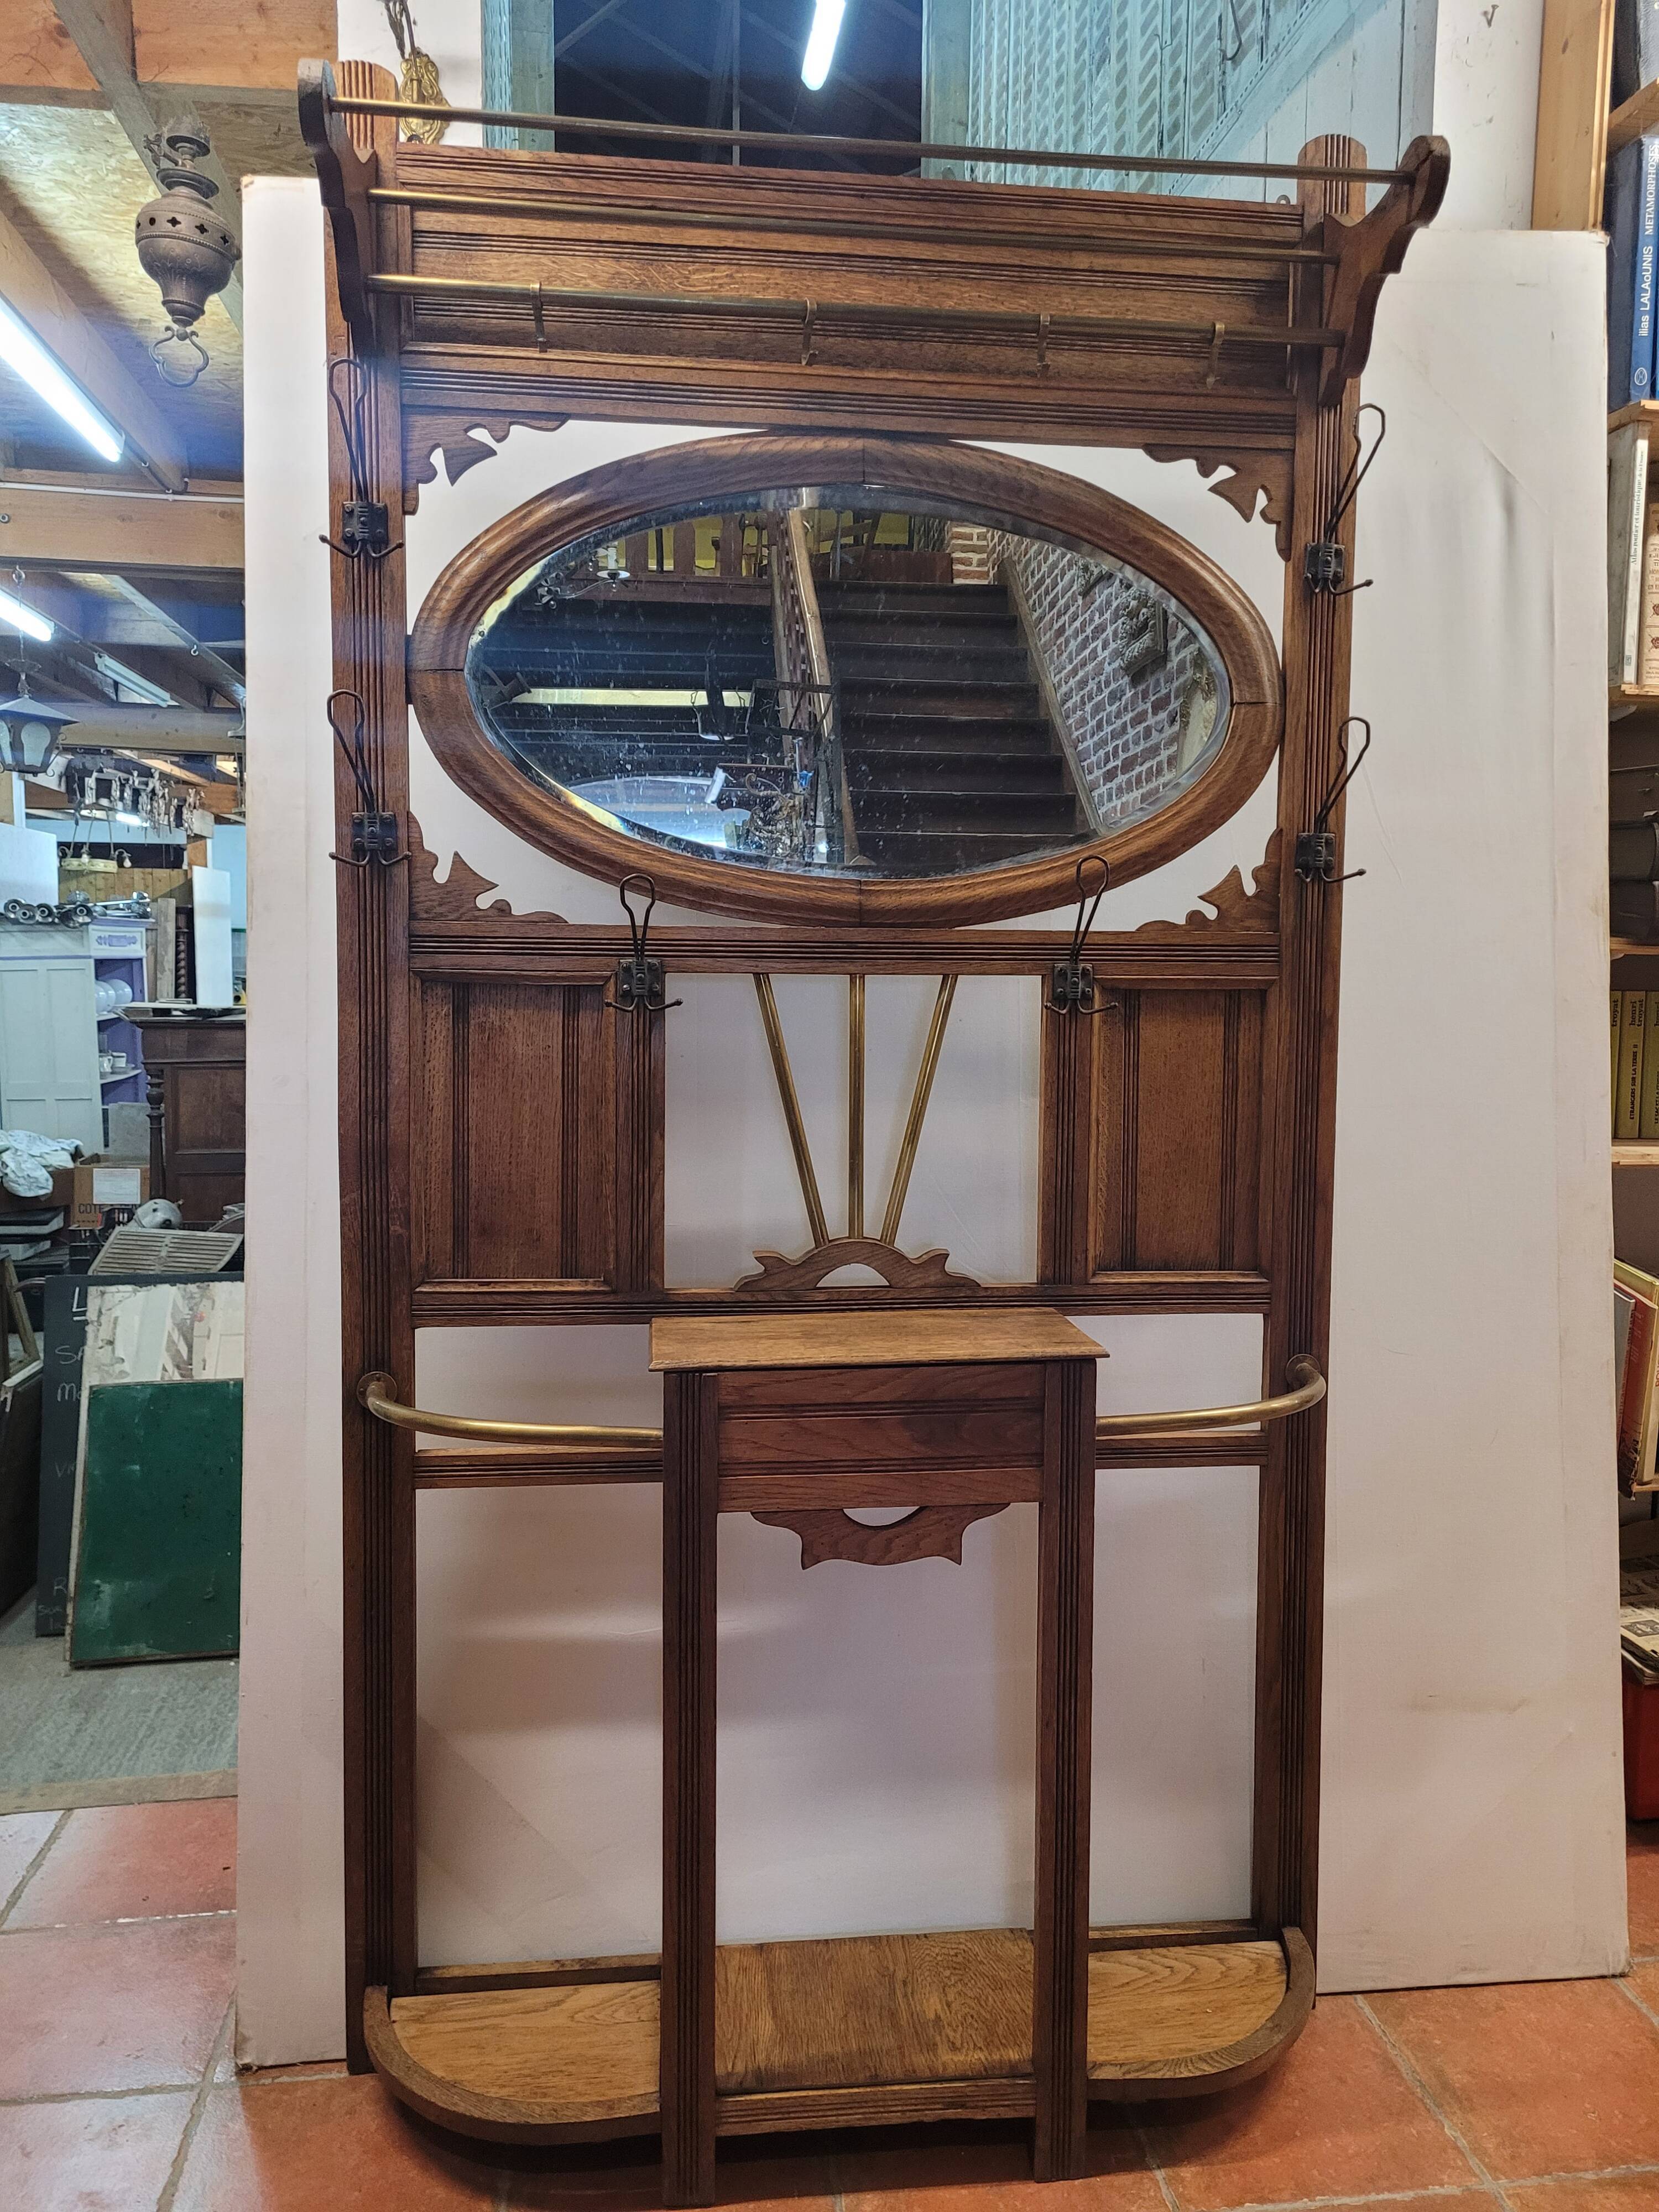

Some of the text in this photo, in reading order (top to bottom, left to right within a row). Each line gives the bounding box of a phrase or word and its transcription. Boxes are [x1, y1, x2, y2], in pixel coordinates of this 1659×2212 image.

[1639, 145, 1657, 336] ilias LALAoUNIS METAMORPHOSES
[1634, 479, 1642, 516] touristique
